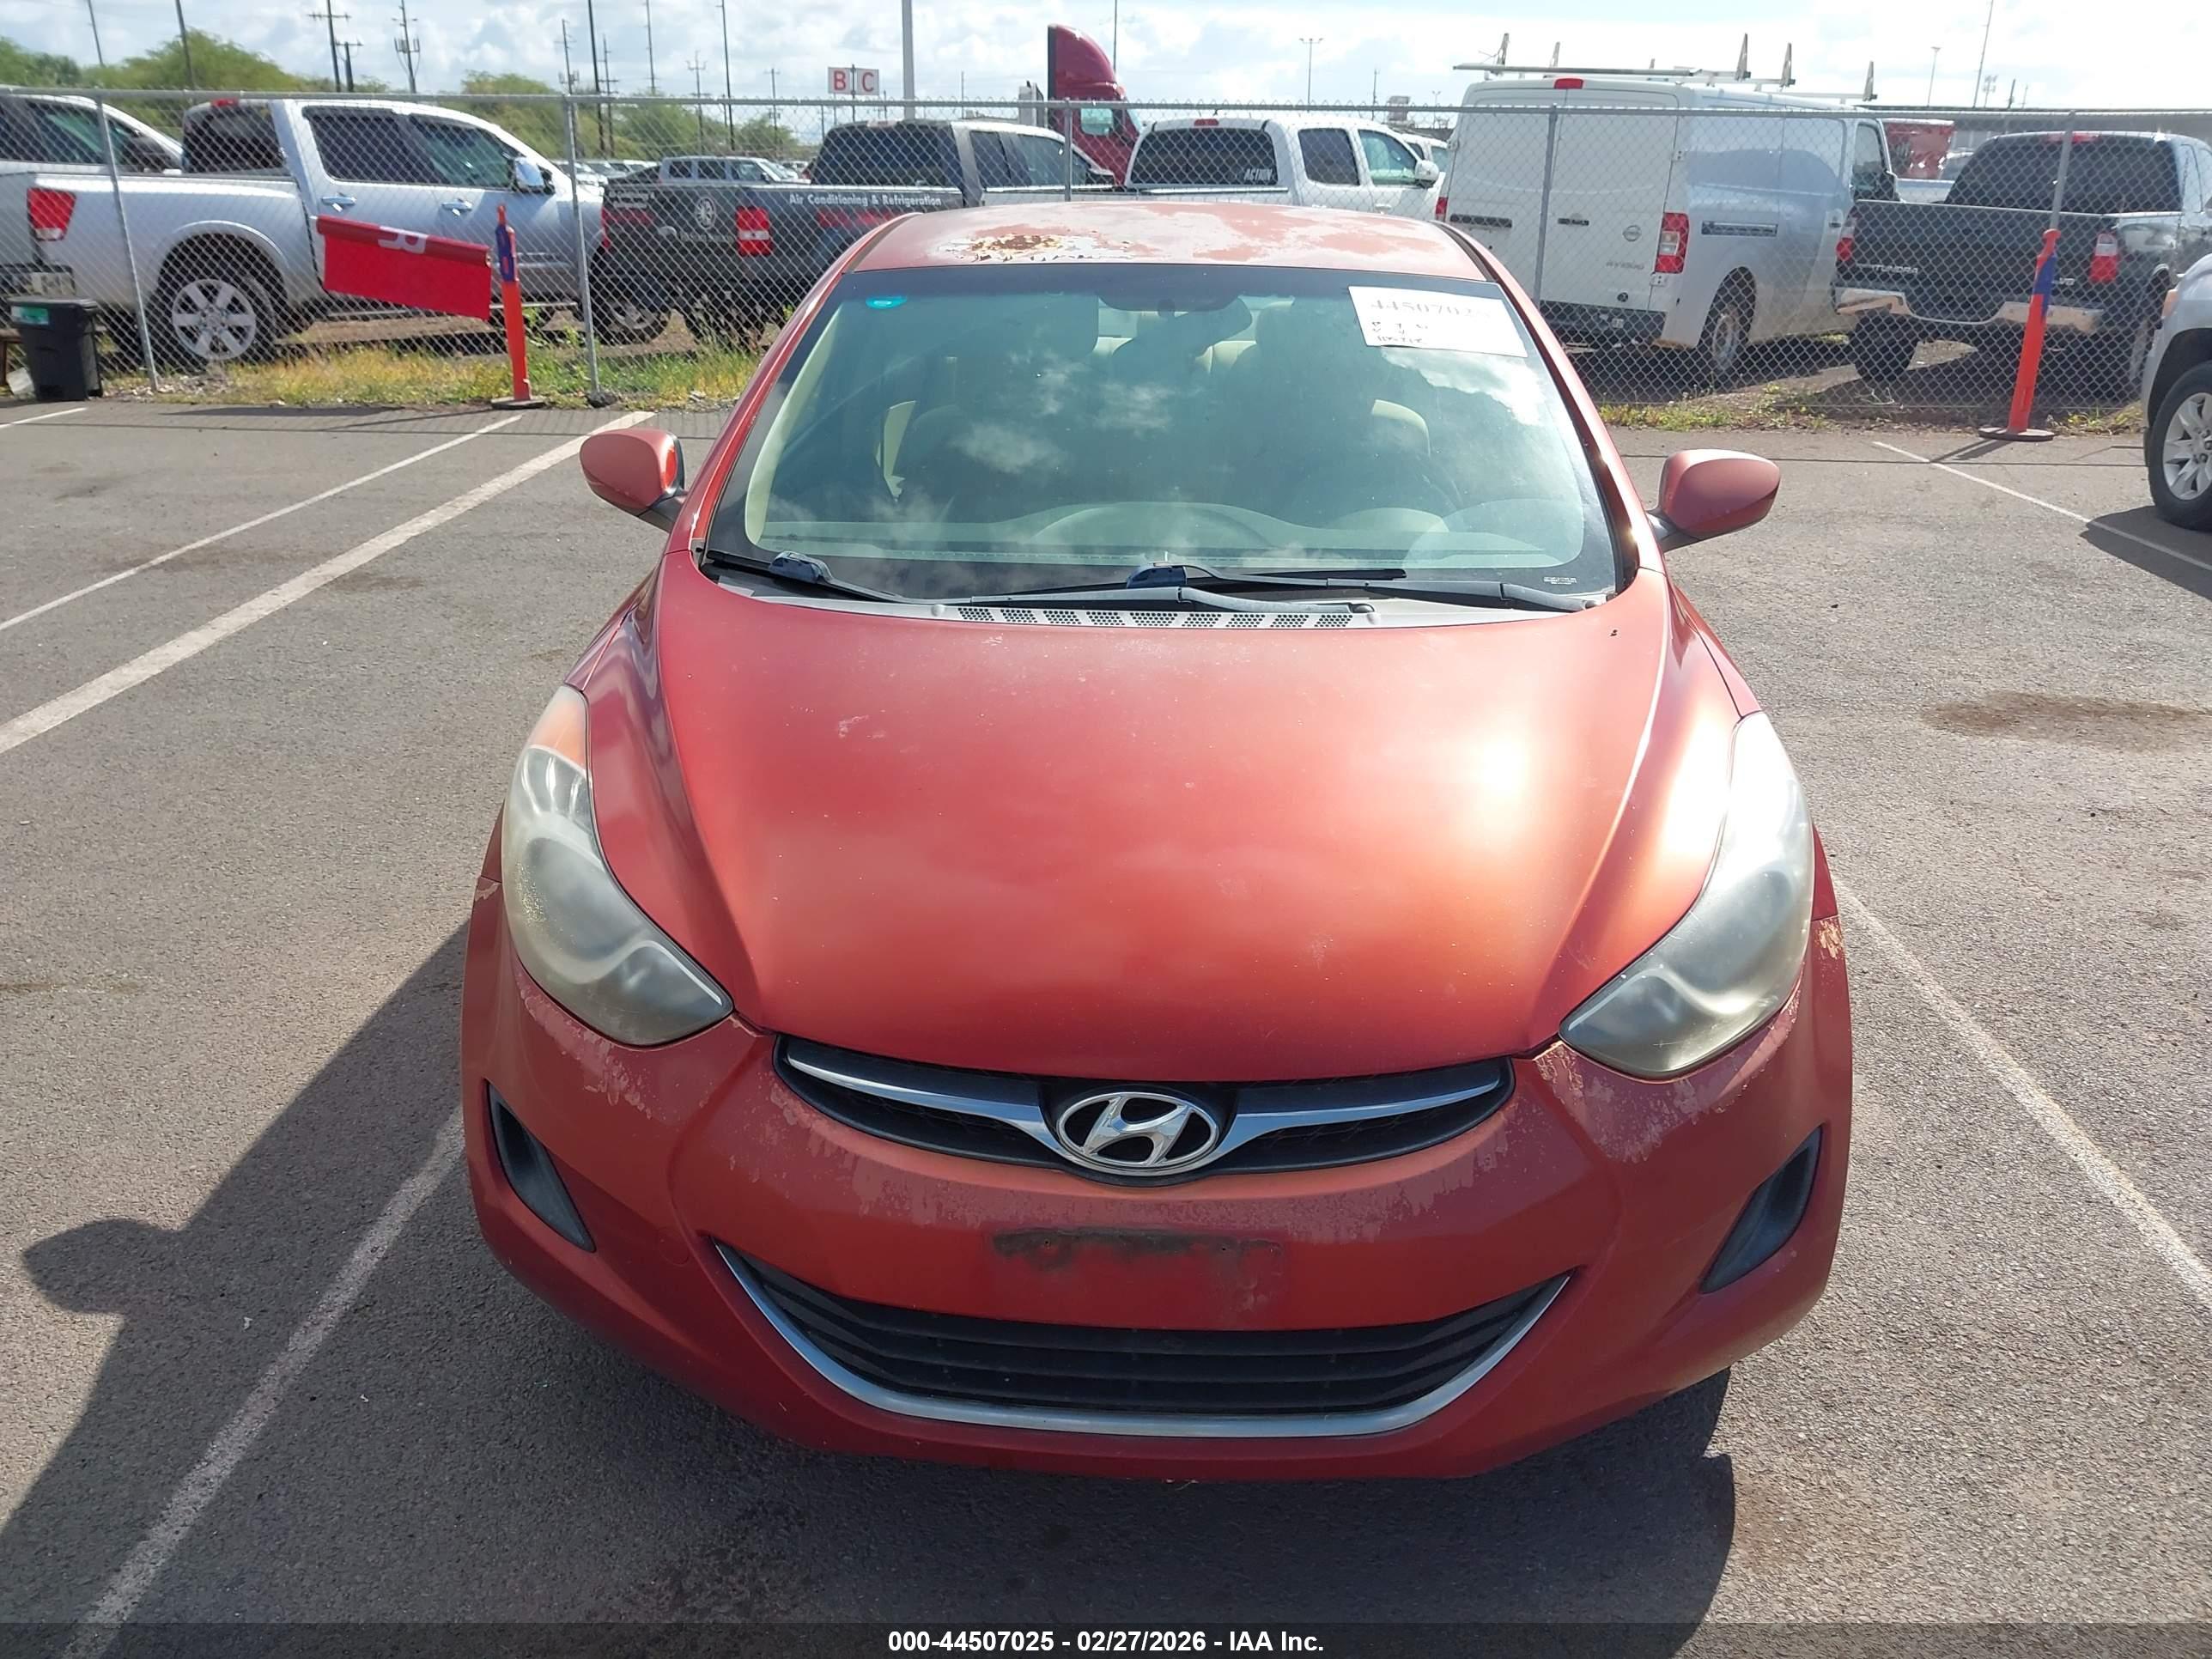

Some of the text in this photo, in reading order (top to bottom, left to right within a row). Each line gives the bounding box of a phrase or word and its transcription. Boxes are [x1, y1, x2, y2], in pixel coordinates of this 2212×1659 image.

[834, 70, 846, 90] B
[862, 72, 874, 92] C
[789, 194, 942, 208] Air Conditioning & Refrigeration
